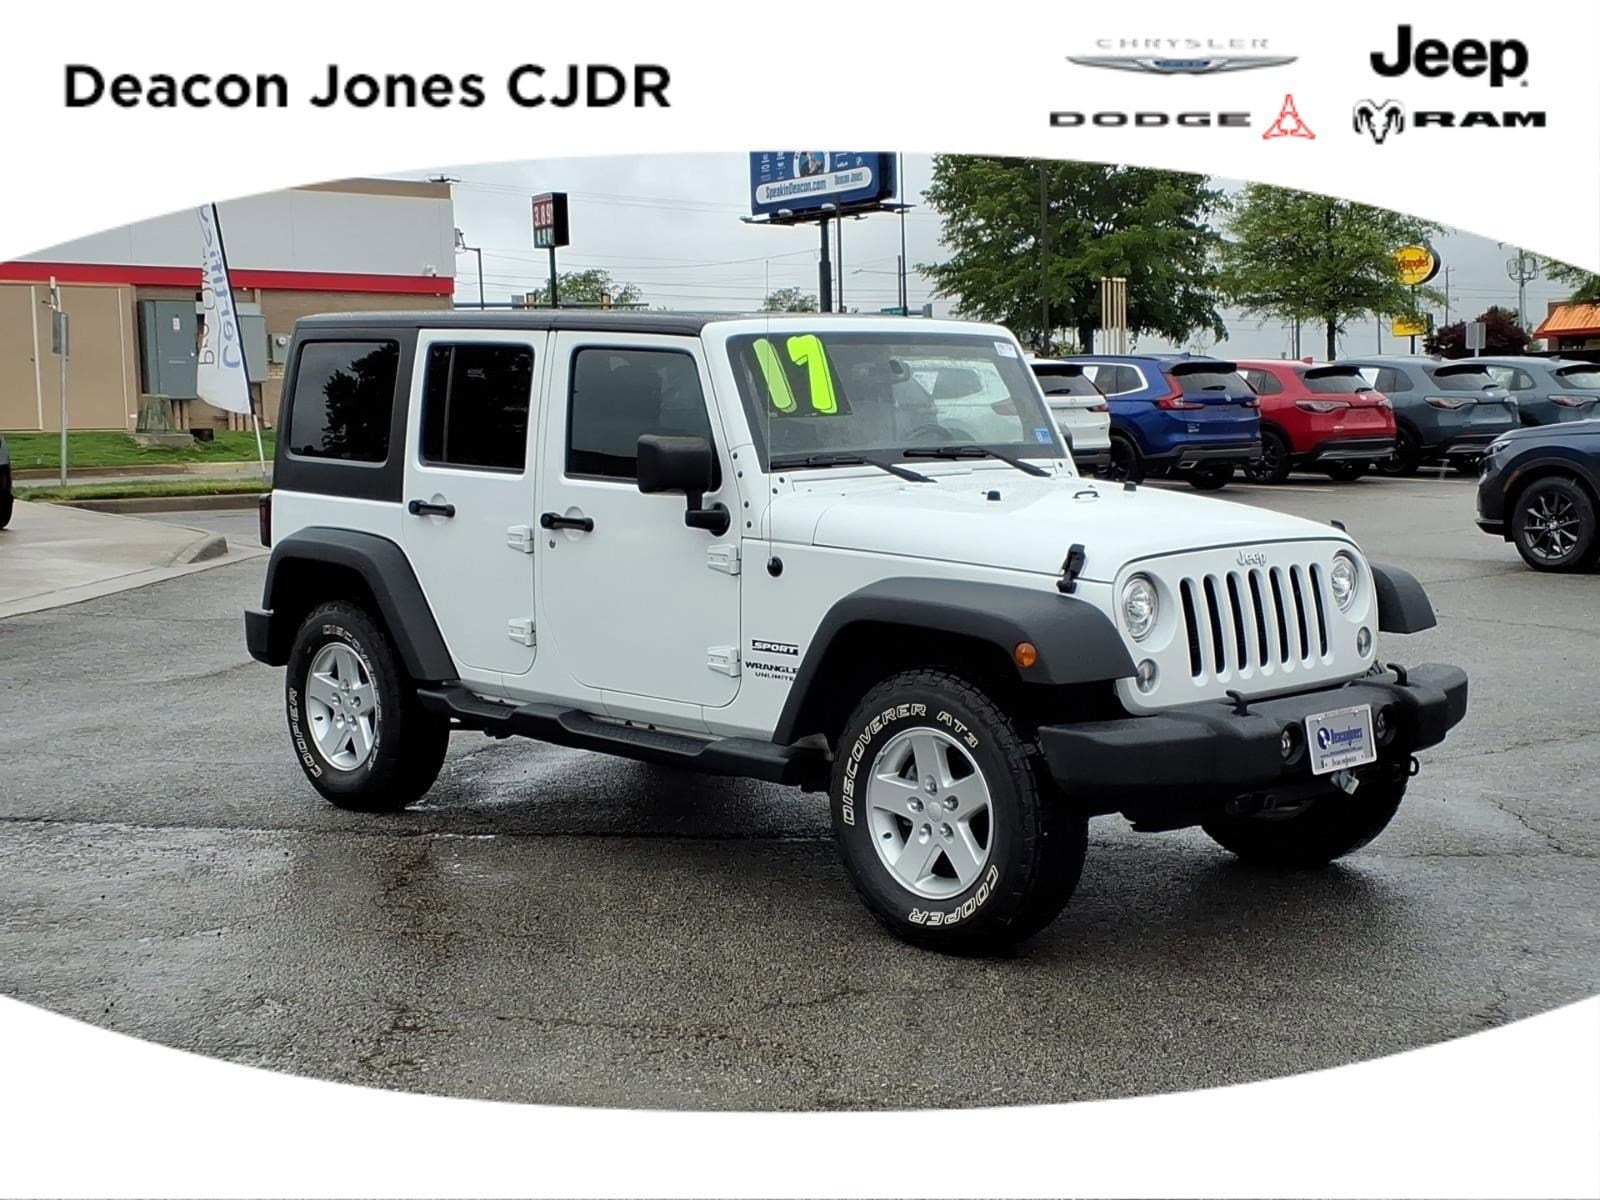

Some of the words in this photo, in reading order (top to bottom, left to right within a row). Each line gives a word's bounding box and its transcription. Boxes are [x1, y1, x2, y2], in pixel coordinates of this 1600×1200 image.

[765, 178, 827, 200] SpeakinDeacon.com
[753, 333, 838, 415] 17
[1236, 550, 1266, 567] Jeep
[753, 640, 798, 655] SPORT
[745, 661, 799, 674] WRANGLE
[755, 671, 795, 681] UNLIMITE
[287, 687, 323, 778] COOPER
[842, 702, 927, 827] DISCOVERER
[936, 710, 979, 749] AT3
[908, 864, 1000, 926] COOPER
